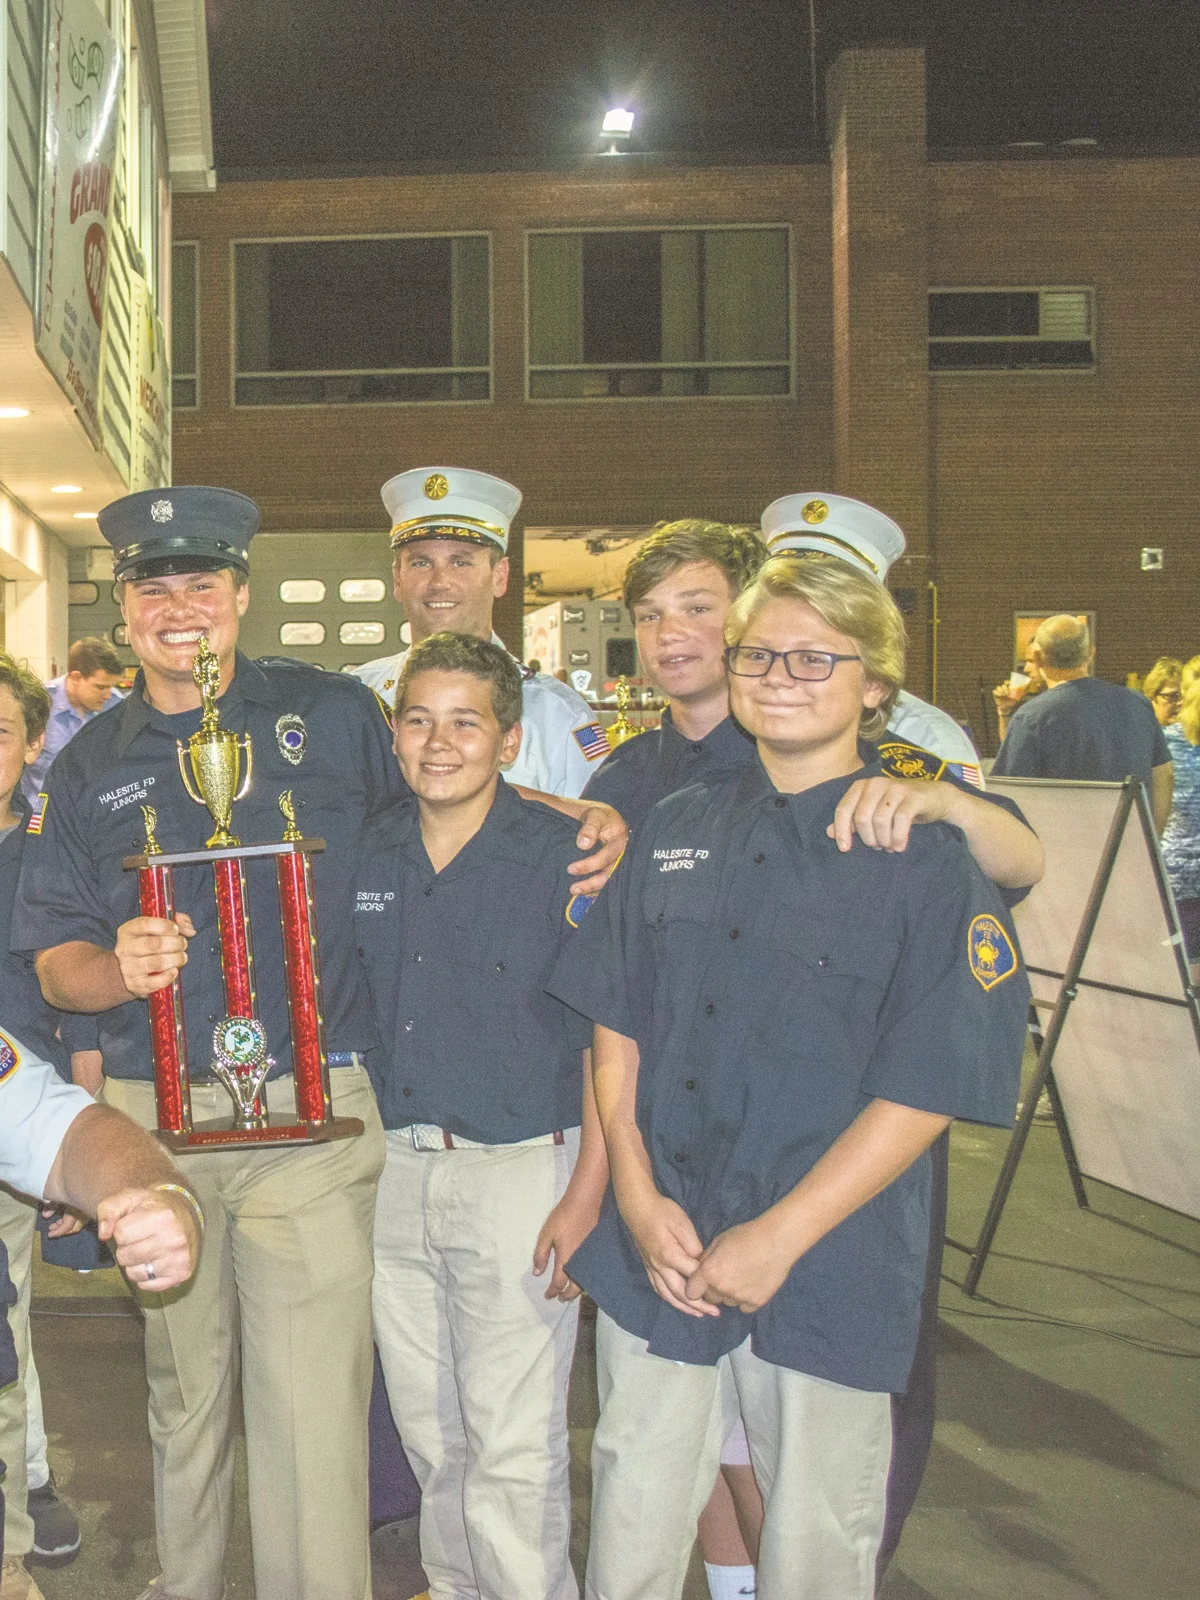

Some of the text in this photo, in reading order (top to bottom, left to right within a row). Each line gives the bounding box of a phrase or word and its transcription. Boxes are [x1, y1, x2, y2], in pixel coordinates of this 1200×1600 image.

[98, 776, 156, 805] HALESITE FD
[111, 789, 148, 811] JUNIORS
[653, 848, 709, 859] HALESITE FD
[659, 859, 695, 872] JUNIORS
[384, 892, 395, 901] FD
